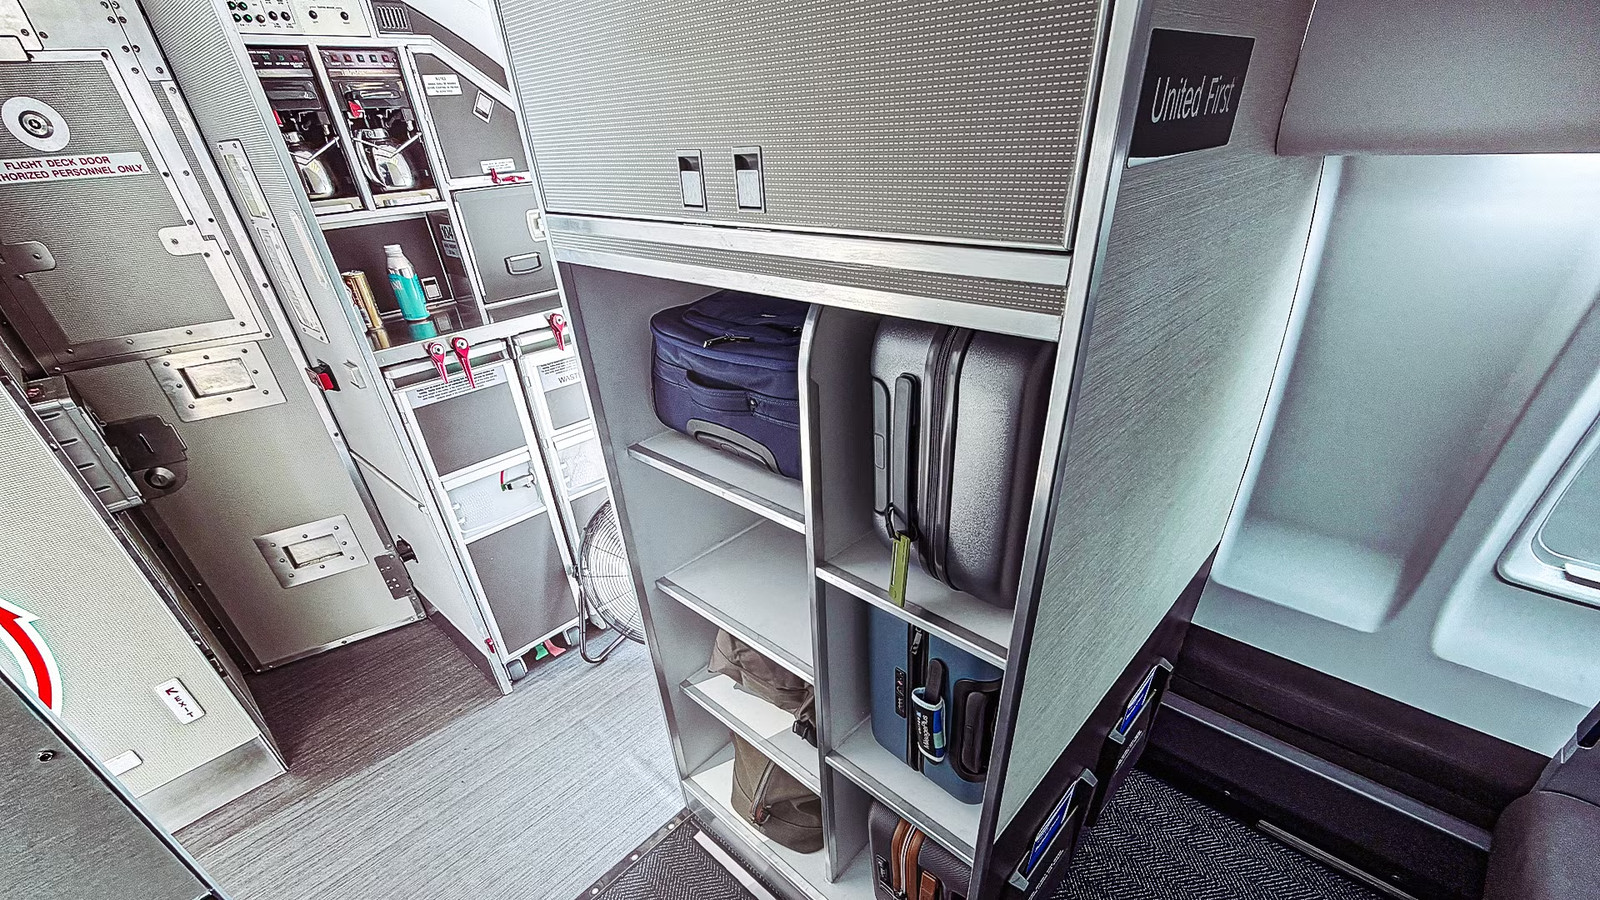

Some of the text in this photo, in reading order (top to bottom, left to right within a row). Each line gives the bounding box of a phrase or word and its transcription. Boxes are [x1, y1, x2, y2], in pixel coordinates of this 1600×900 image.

[1151, 75, 1235, 123] United First
[3, 156, 111, 170] FLIGHT DECK DOOR
[0, 164, 143, 182] HORIZED PERSONNEL ONLY
[557, 372, 580, 384] WAST
[174, 695, 194, 717] EXIT
